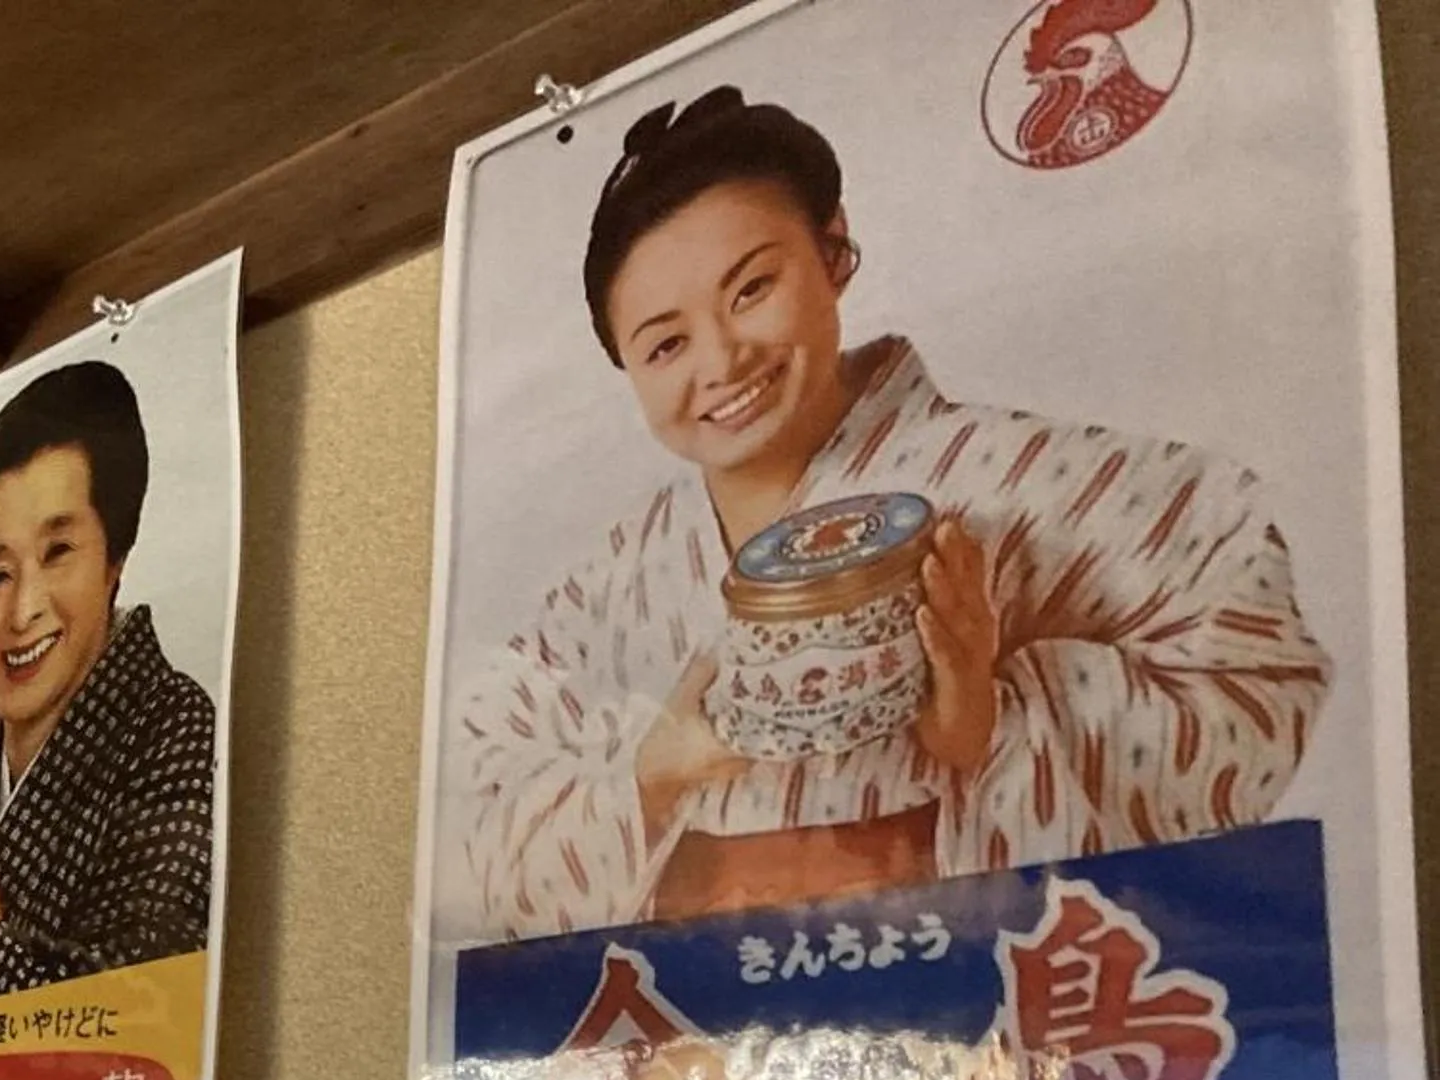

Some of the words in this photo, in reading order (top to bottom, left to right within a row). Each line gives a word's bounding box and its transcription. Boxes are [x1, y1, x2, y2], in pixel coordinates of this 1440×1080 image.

[736, 911, 952, 984] きんちょう
